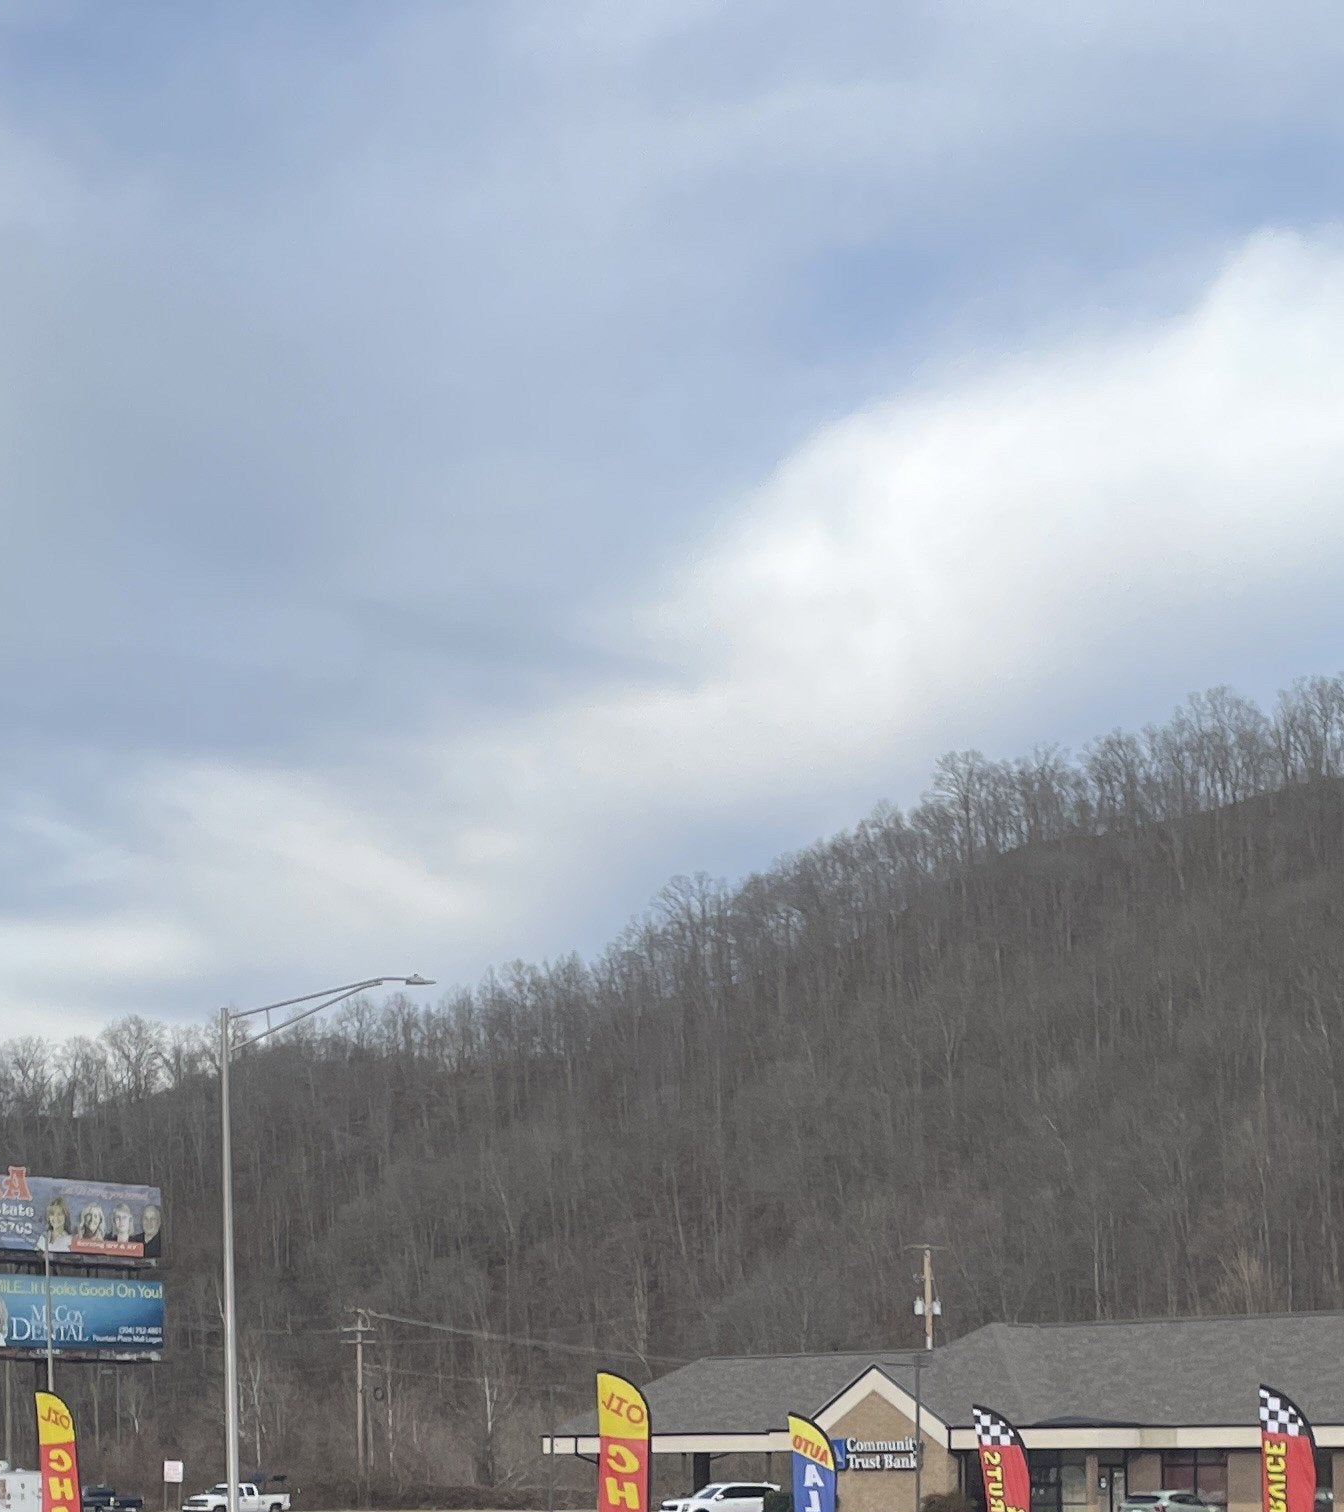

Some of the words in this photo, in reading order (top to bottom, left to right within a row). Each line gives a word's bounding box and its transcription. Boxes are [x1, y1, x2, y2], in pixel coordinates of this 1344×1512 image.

[79, 1281, 115, 1297] Good
[117, 1283, 136, 1298] On
[137, 1284, 163, 1299] You!
[846, 1453, 881, 1469] Trust
[883, 1453, 917, 1469] Bank
